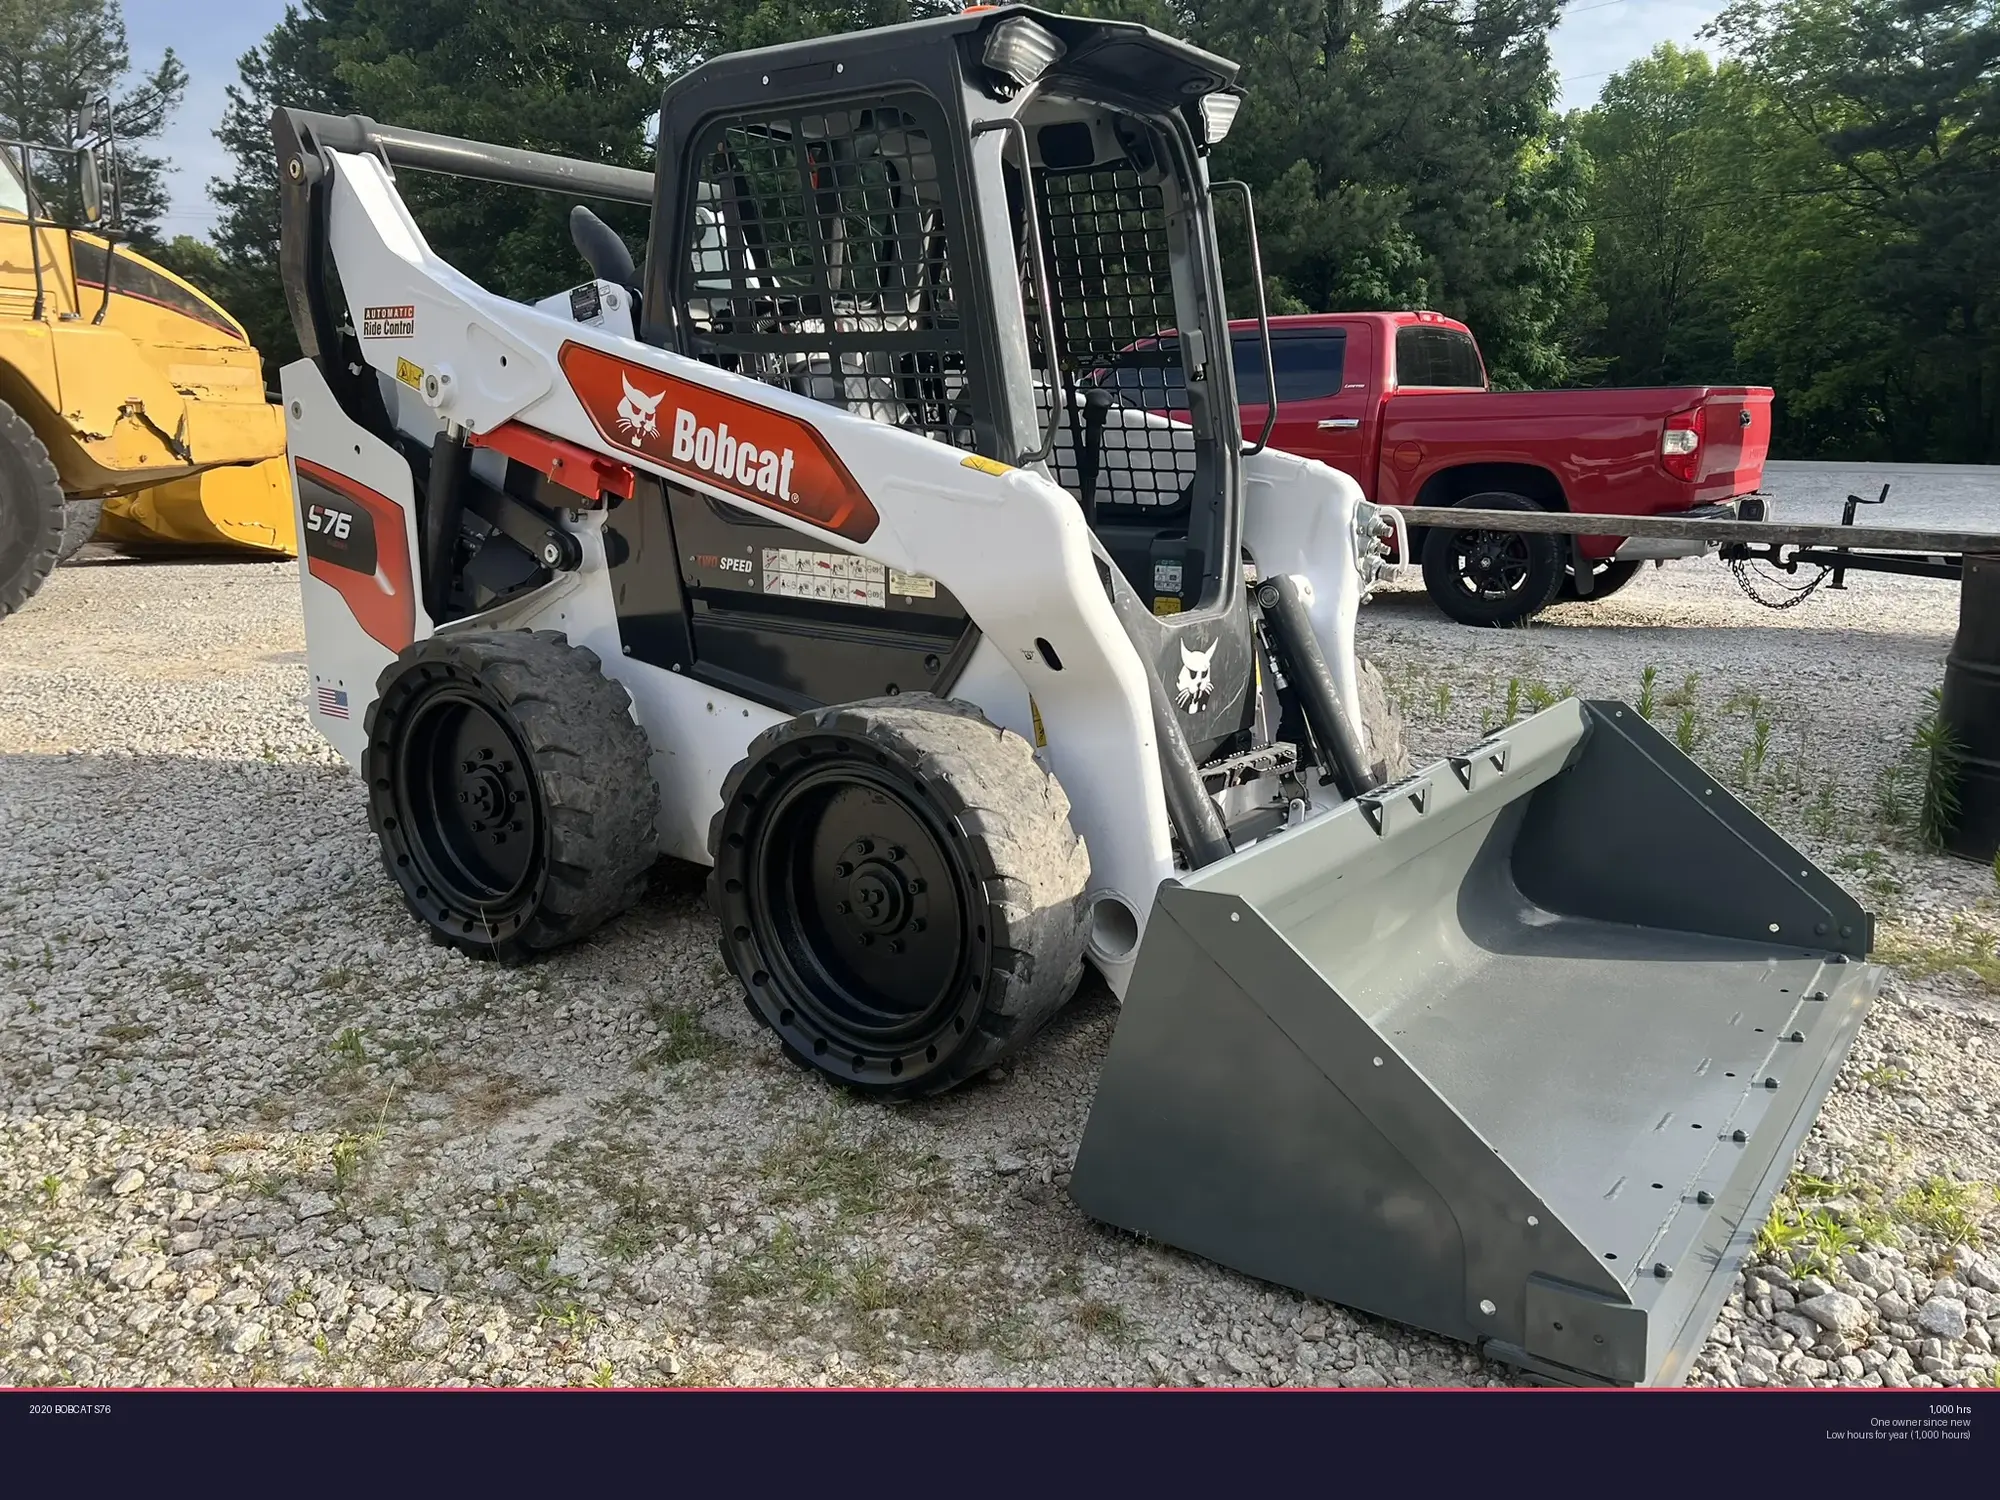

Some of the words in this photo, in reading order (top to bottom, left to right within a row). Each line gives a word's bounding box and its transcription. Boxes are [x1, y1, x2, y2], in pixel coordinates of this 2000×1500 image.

[366, 308, 413, 319] AUTOMATIC
[363, 321, 382, 336] Ride
[383, 319, 414, 335] Control
[307, 504, 353, 540] S76
[697, 555, 718, 568] TWO
[719, 557, 753, 573] SPEED
